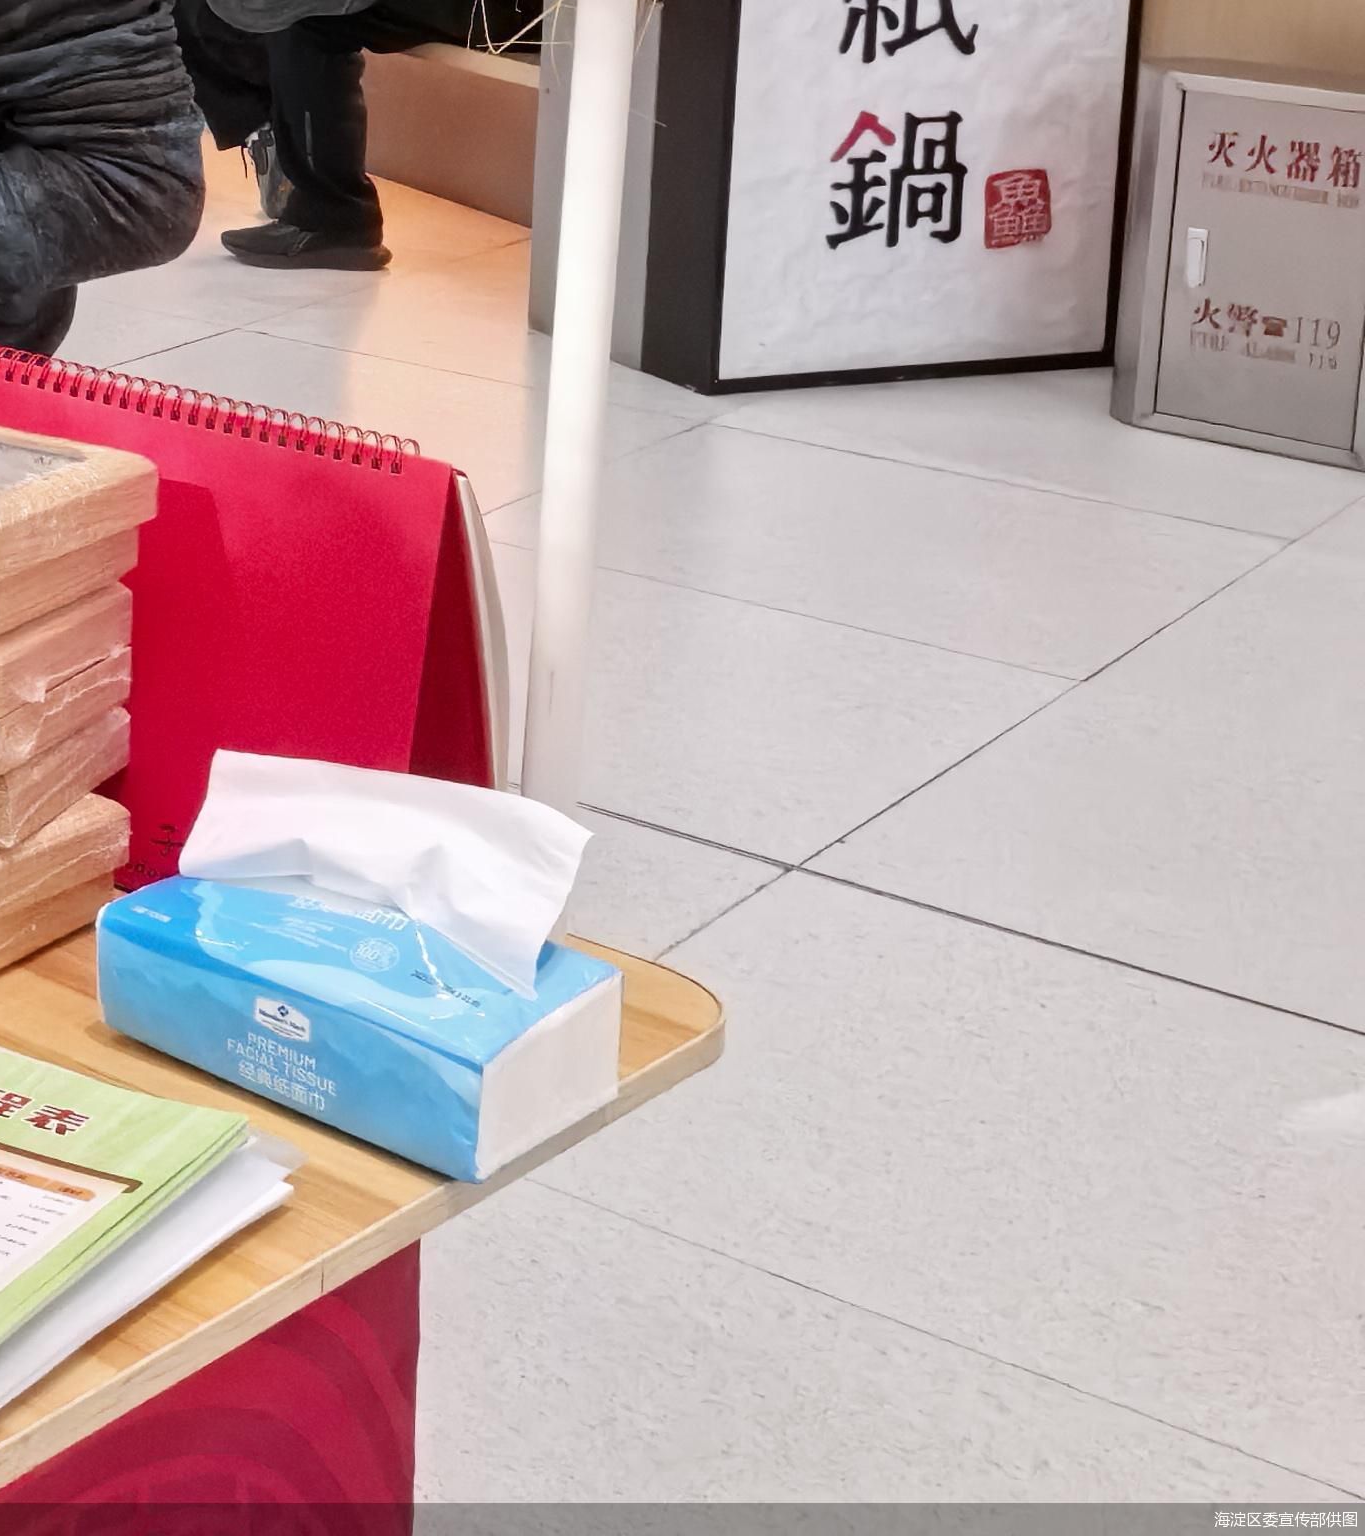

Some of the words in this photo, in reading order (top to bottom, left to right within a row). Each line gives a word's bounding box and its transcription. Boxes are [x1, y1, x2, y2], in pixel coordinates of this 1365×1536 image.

[1208, 131, 1363, 189] 灭火器箱
[227, 1038, 279, 1073] FACIAL
[283, 1061, 337, 1097] TISSUE
[247, 1031, 316, 1070] PREMIUM
